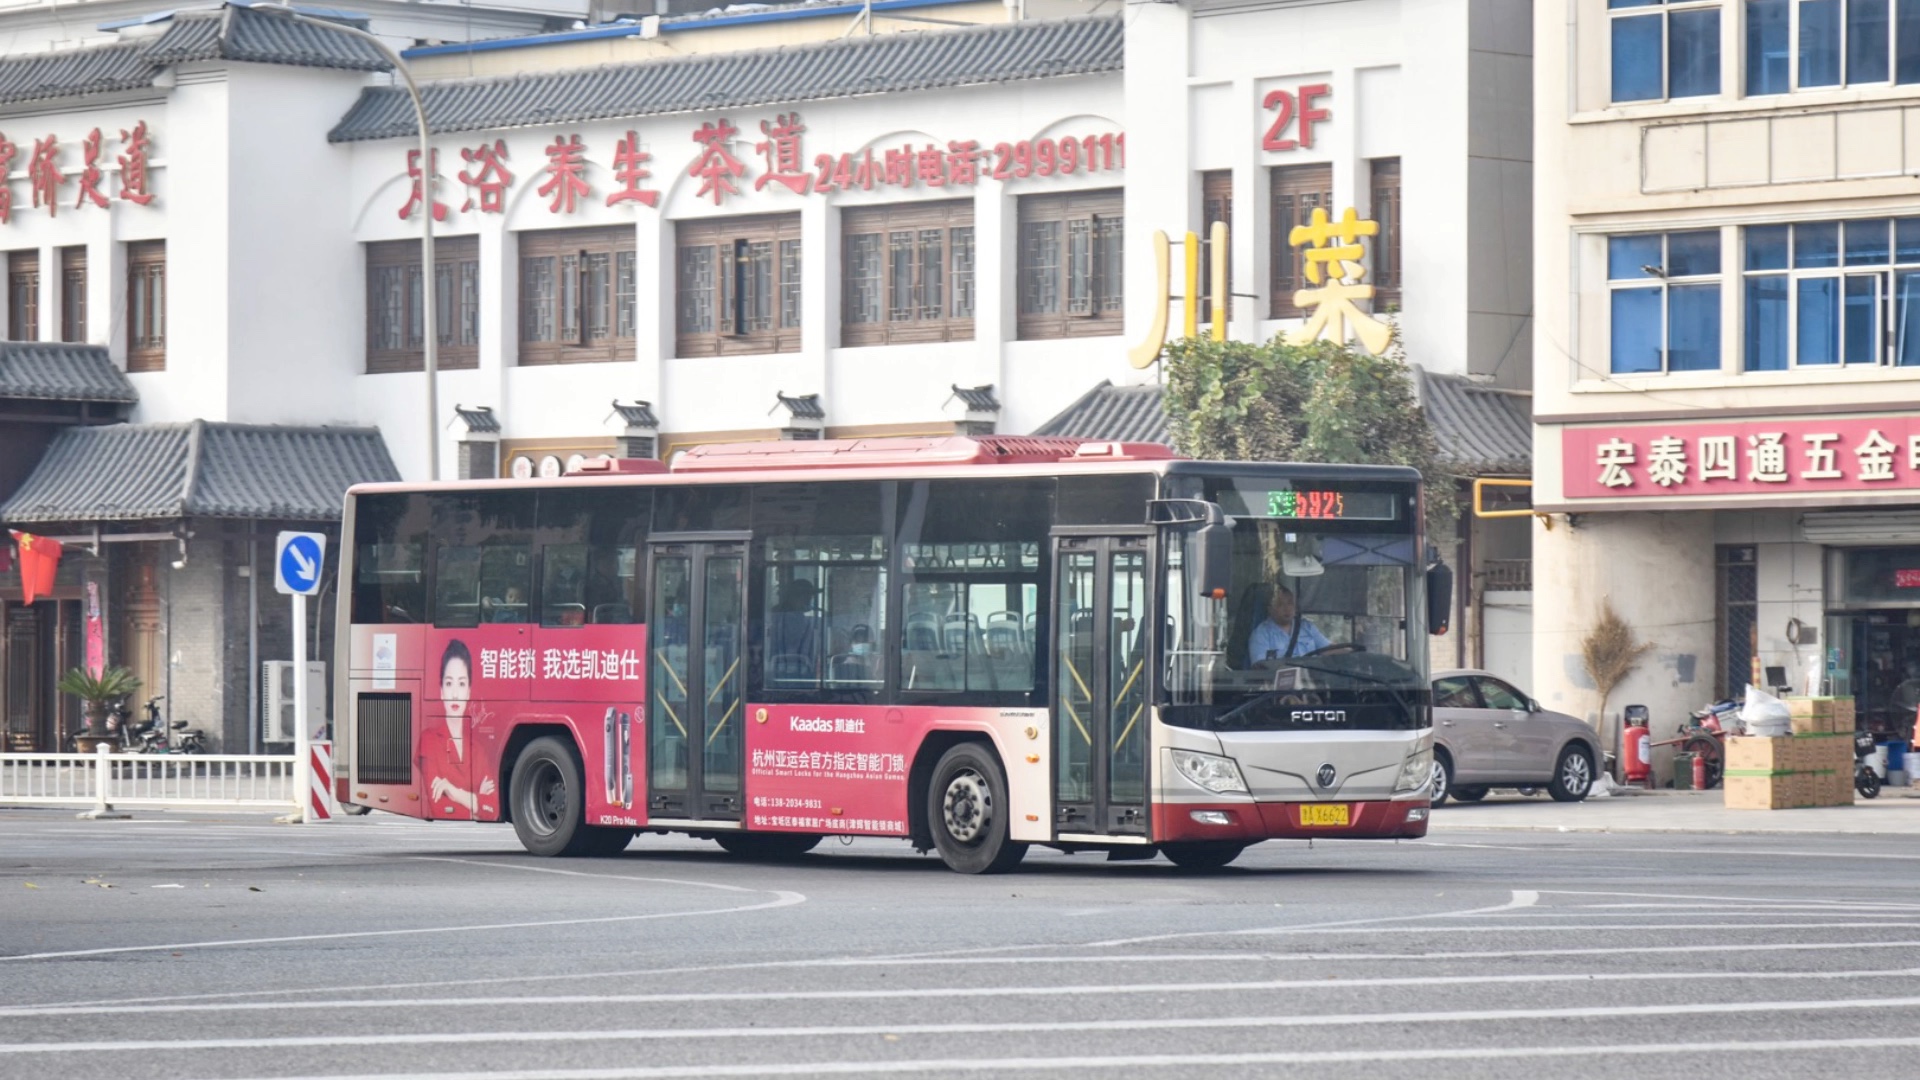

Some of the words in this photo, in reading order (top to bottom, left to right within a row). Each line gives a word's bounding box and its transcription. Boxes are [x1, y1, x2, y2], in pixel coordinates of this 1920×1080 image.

[1263, 83, 1332, 151] 2F
[398, 111, 812, 222] 足浴养生茶道
[1128, 206, 1393, 369] 川菜
[480, 648, 536, 679] 智能锁
[542, 648, 640, 681] 我选凯迪仕
[790, 716, 833, 732] Kaadas
[835, 718, 865, 734] 凯迪仕
[1290, 710, 1346, 722] FOTON
[752, 749, 905, 773] 杭州亚运会官方指定智能门锁
